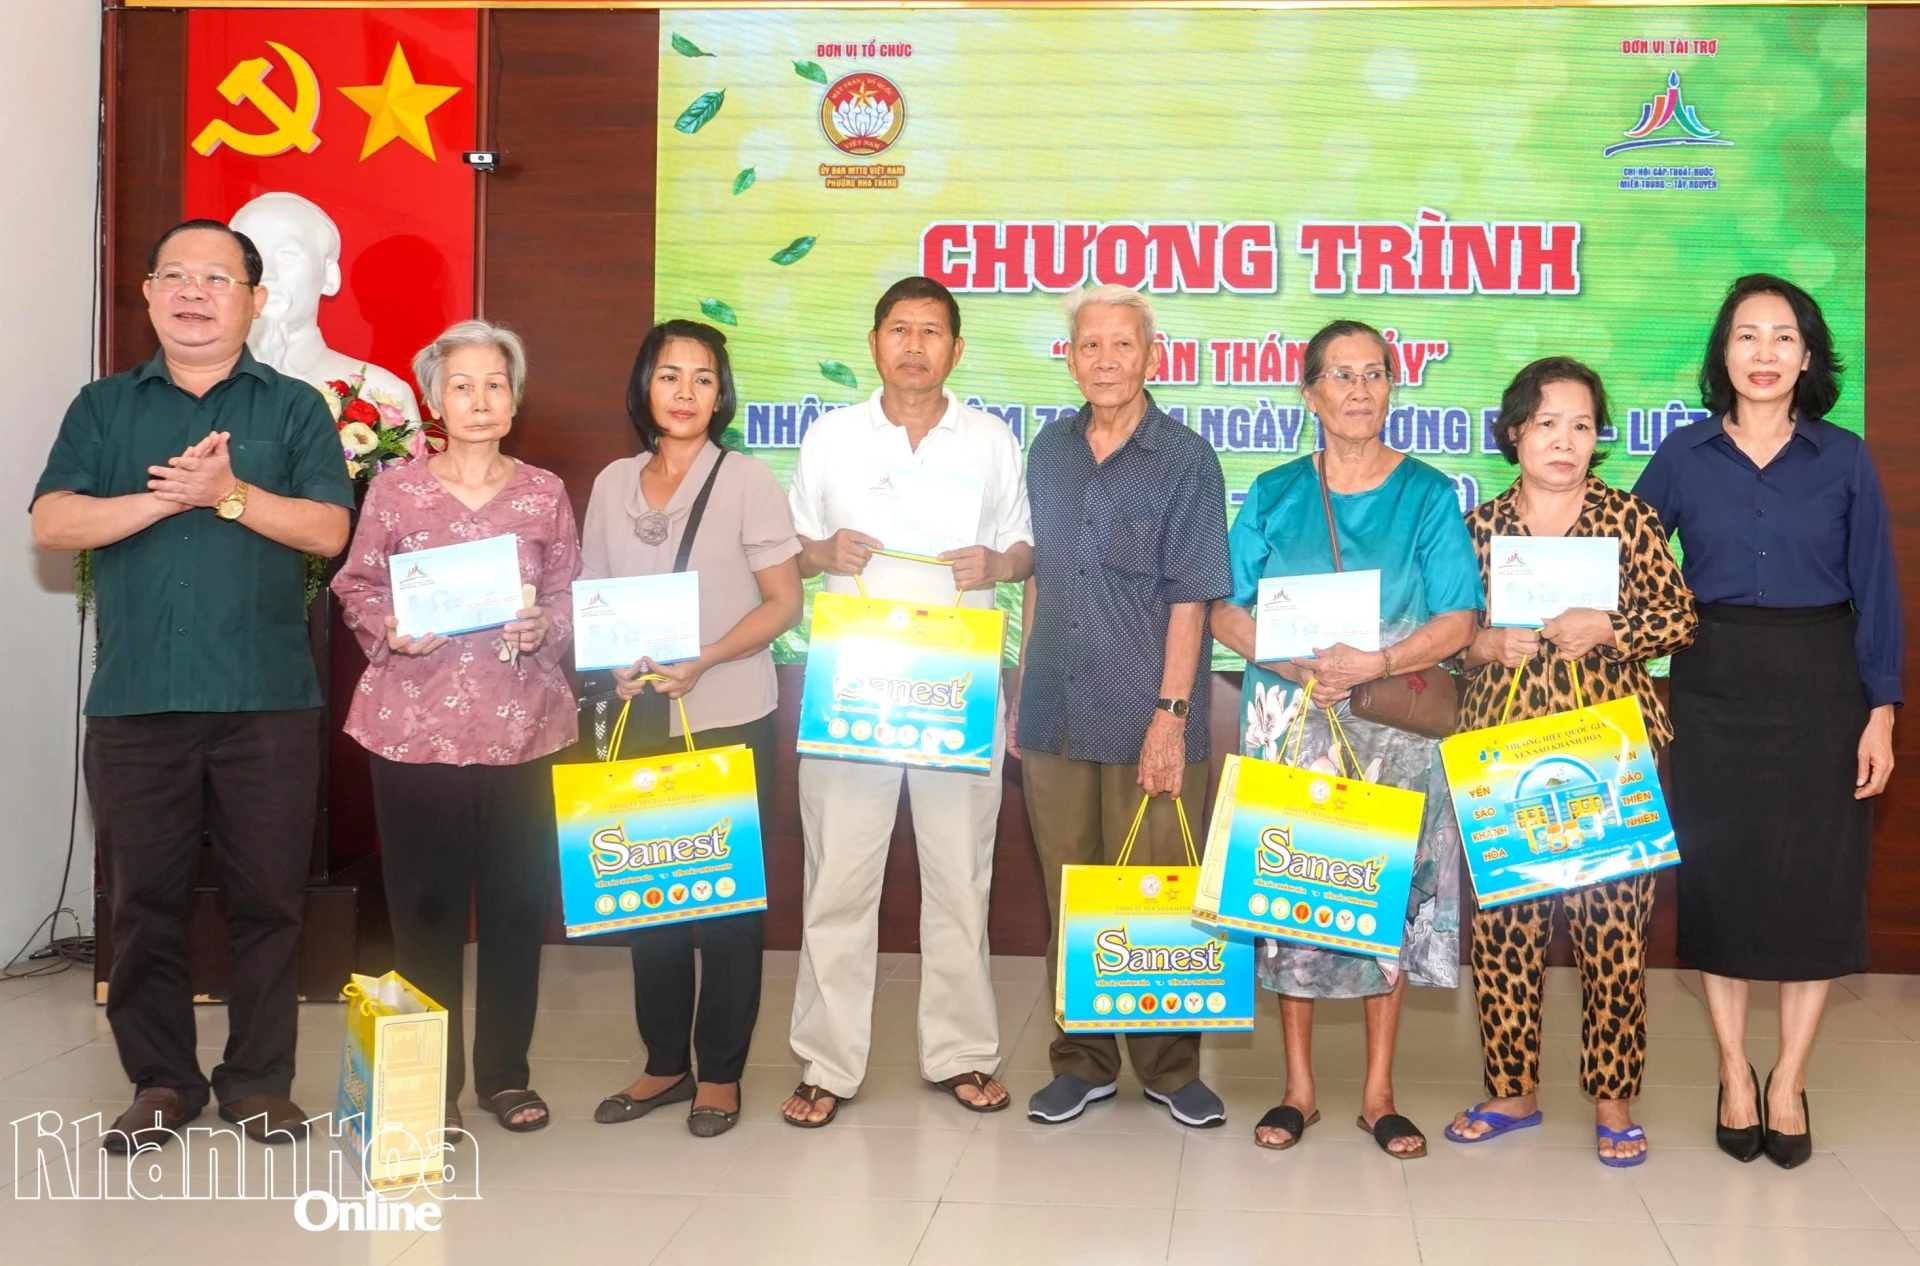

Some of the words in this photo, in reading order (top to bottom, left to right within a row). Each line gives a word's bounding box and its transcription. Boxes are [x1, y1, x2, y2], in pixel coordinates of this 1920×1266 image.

[817, 43, 841, 57] ĐƠN
[845, 44, 857, 60] VỊ
[861, 38, 876, 57] TỔ
[880, 41, 912, 57] CHỨC
[1622, 39, 1648, 54] ĐƠN
[1652, 40, 1665, 57] VỊ
[1669, 37, 1688, 54] TÀI
[1693, 39, 1717, 57] TRỢ
[886, 165, 904, 175] NAM
[874, 179, 898, 187] TRANG
[922, 223, 1275, 290] CHƯƠNG
[1300, 209, 1577, 290] TRÌNH
[1210, 332, 1308, 383] THÁN
[747, 396, 848, 446] NHÂ
[1200, 399, 1302, 449] NGÀY
[1614, 751, 1637, 763] YN
[1469, 785, 1491, 798] YẾN
[1622, 791, 1652, 806] THIÊN
[1474, 807, 1495, 820] SÀO
[1626, 812, 1659, 827] NHIÊN
[1472, 825, 1508, 842] KHÁNH
[591, 823, 729, 877] Sanest
[1484, 847, 1507, 861] HÒA
[1256, 827, 1381, 892] Sanest
[1095, 926, 1222, 975] Sanest
